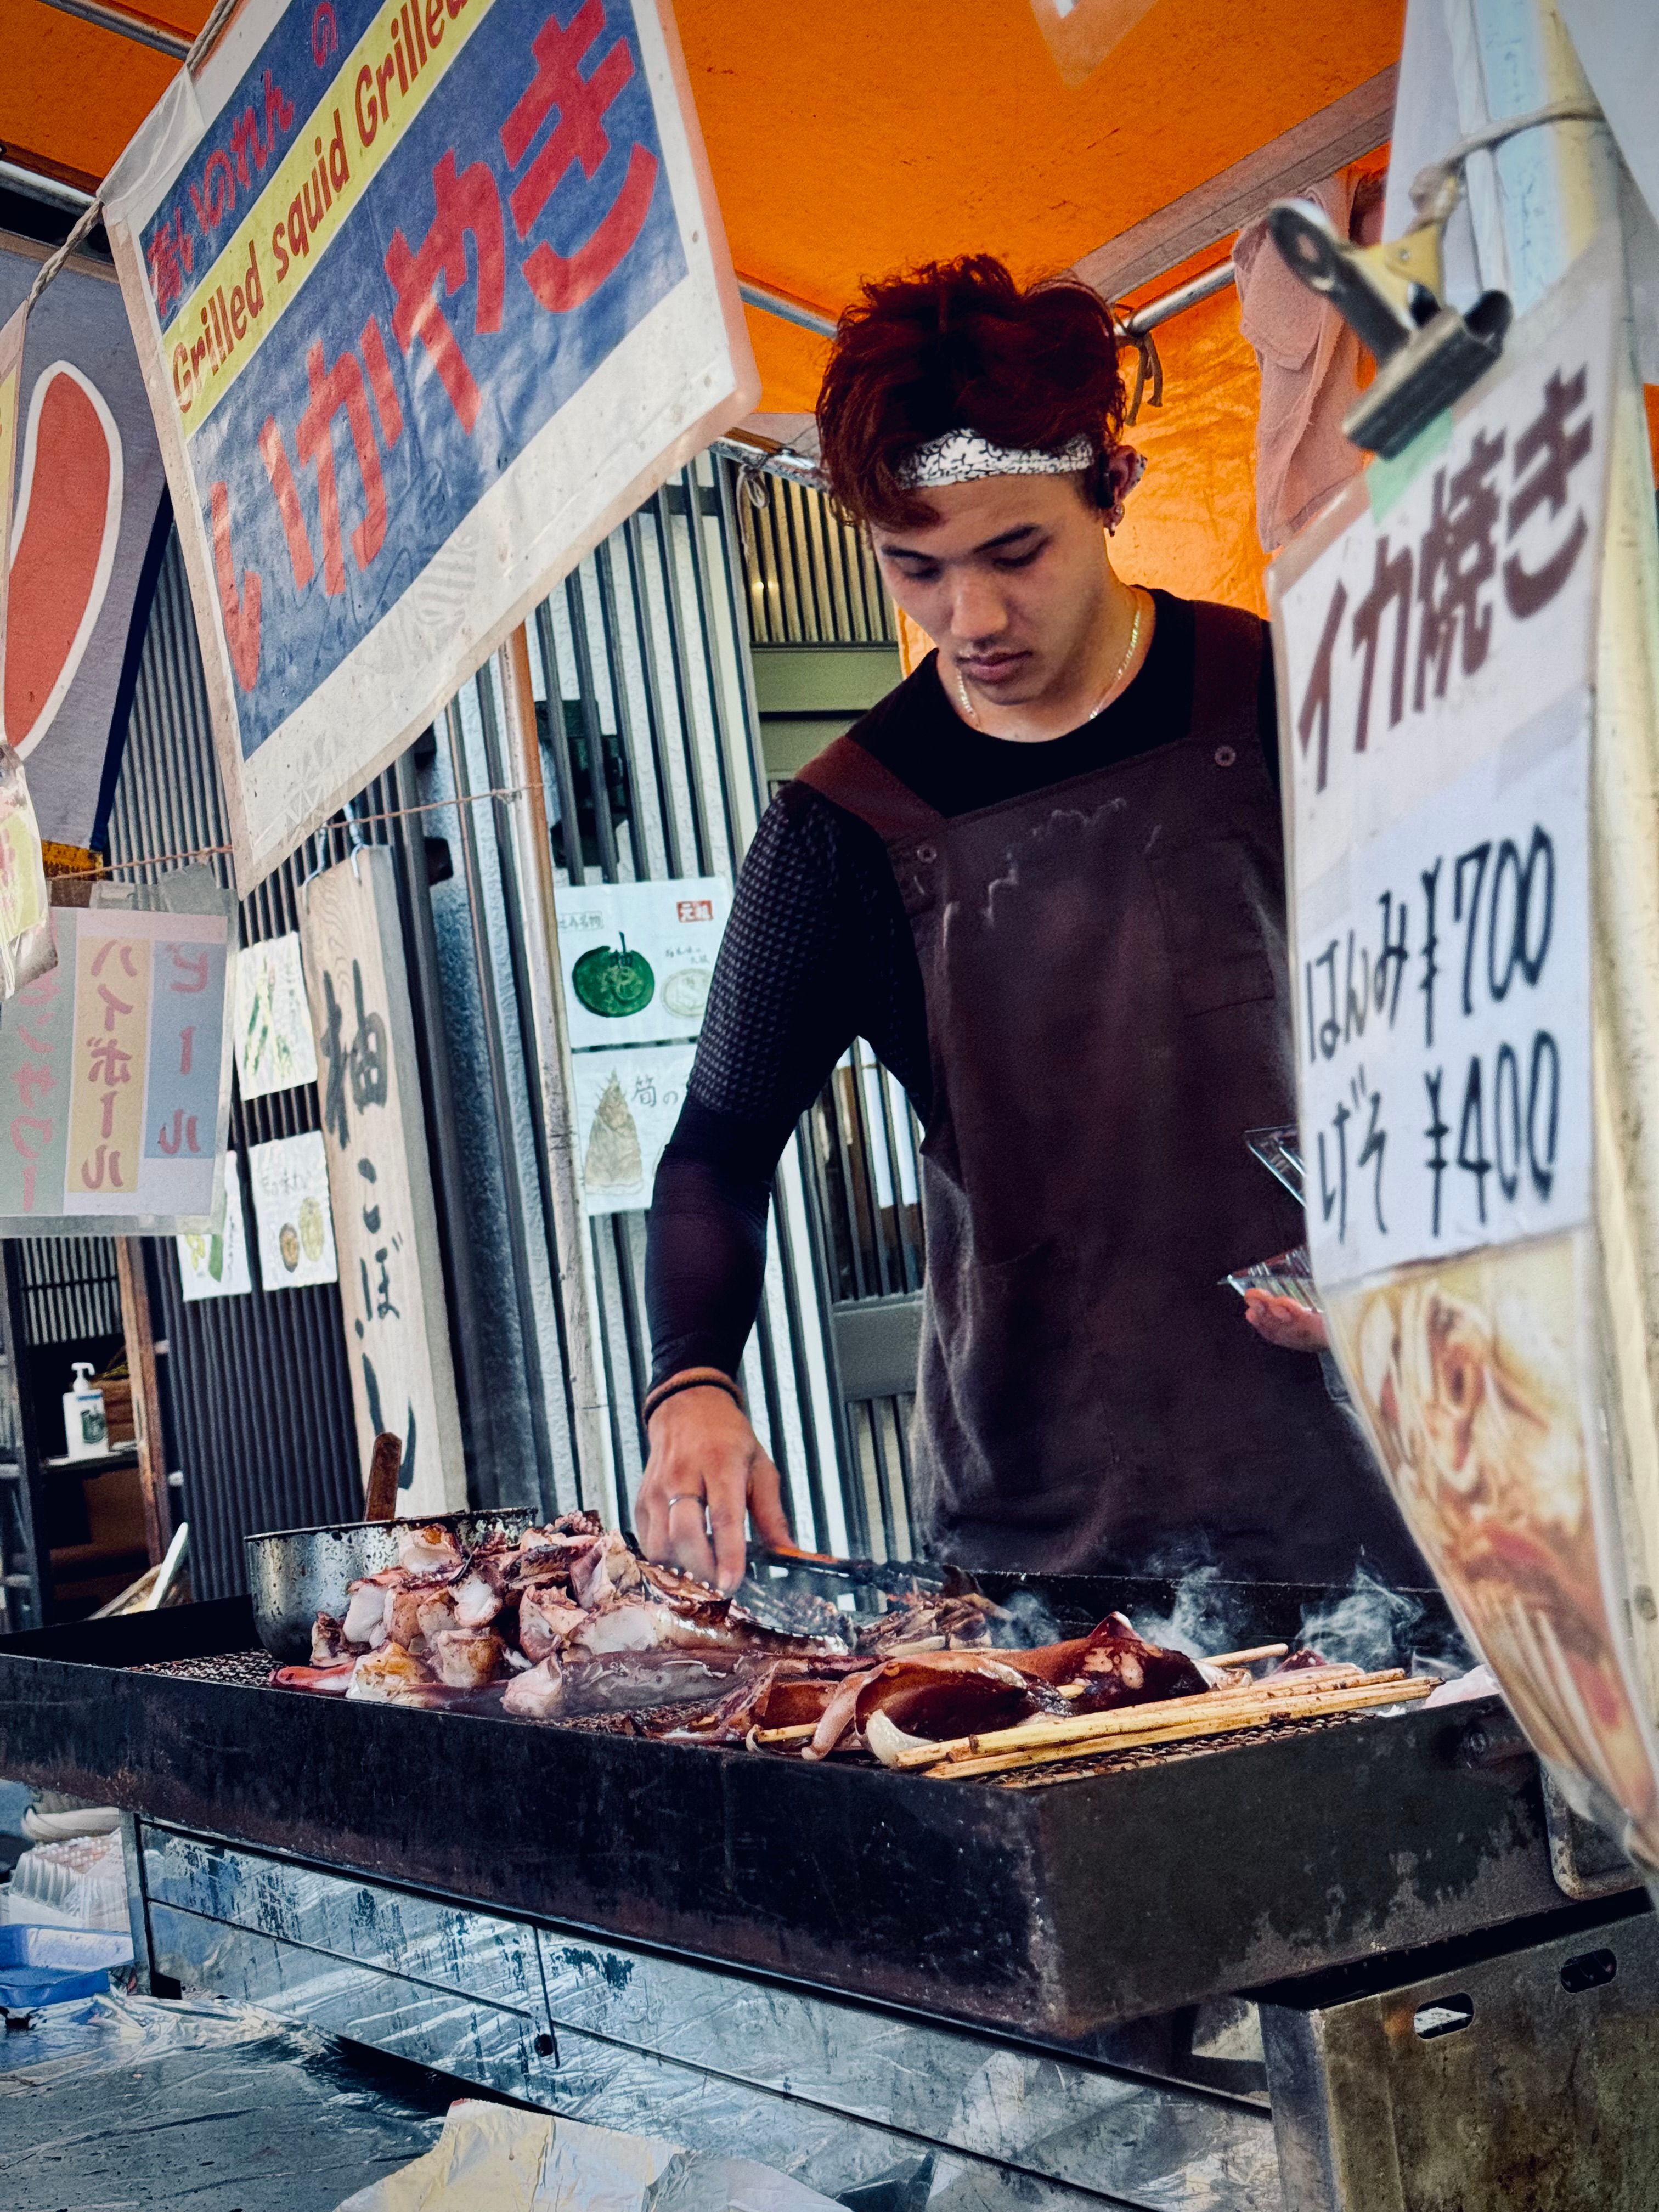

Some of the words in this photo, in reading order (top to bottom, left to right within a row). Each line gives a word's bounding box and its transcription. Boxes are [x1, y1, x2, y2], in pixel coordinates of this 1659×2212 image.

[172, 240, 264, 414] Grilled
[272, 109, 351, 284] squid
[210, 0, 659, 693] いかやき
[1297, 362, 1594, 794] イカ焼き
[1306, 890, 1409, 1064] はんみ
[1420, 821, 1558, 1049] ¥700
[1316, 1065, 1389, 1244] げそ
[1424, 1029, 1561, 1238] ¥400
